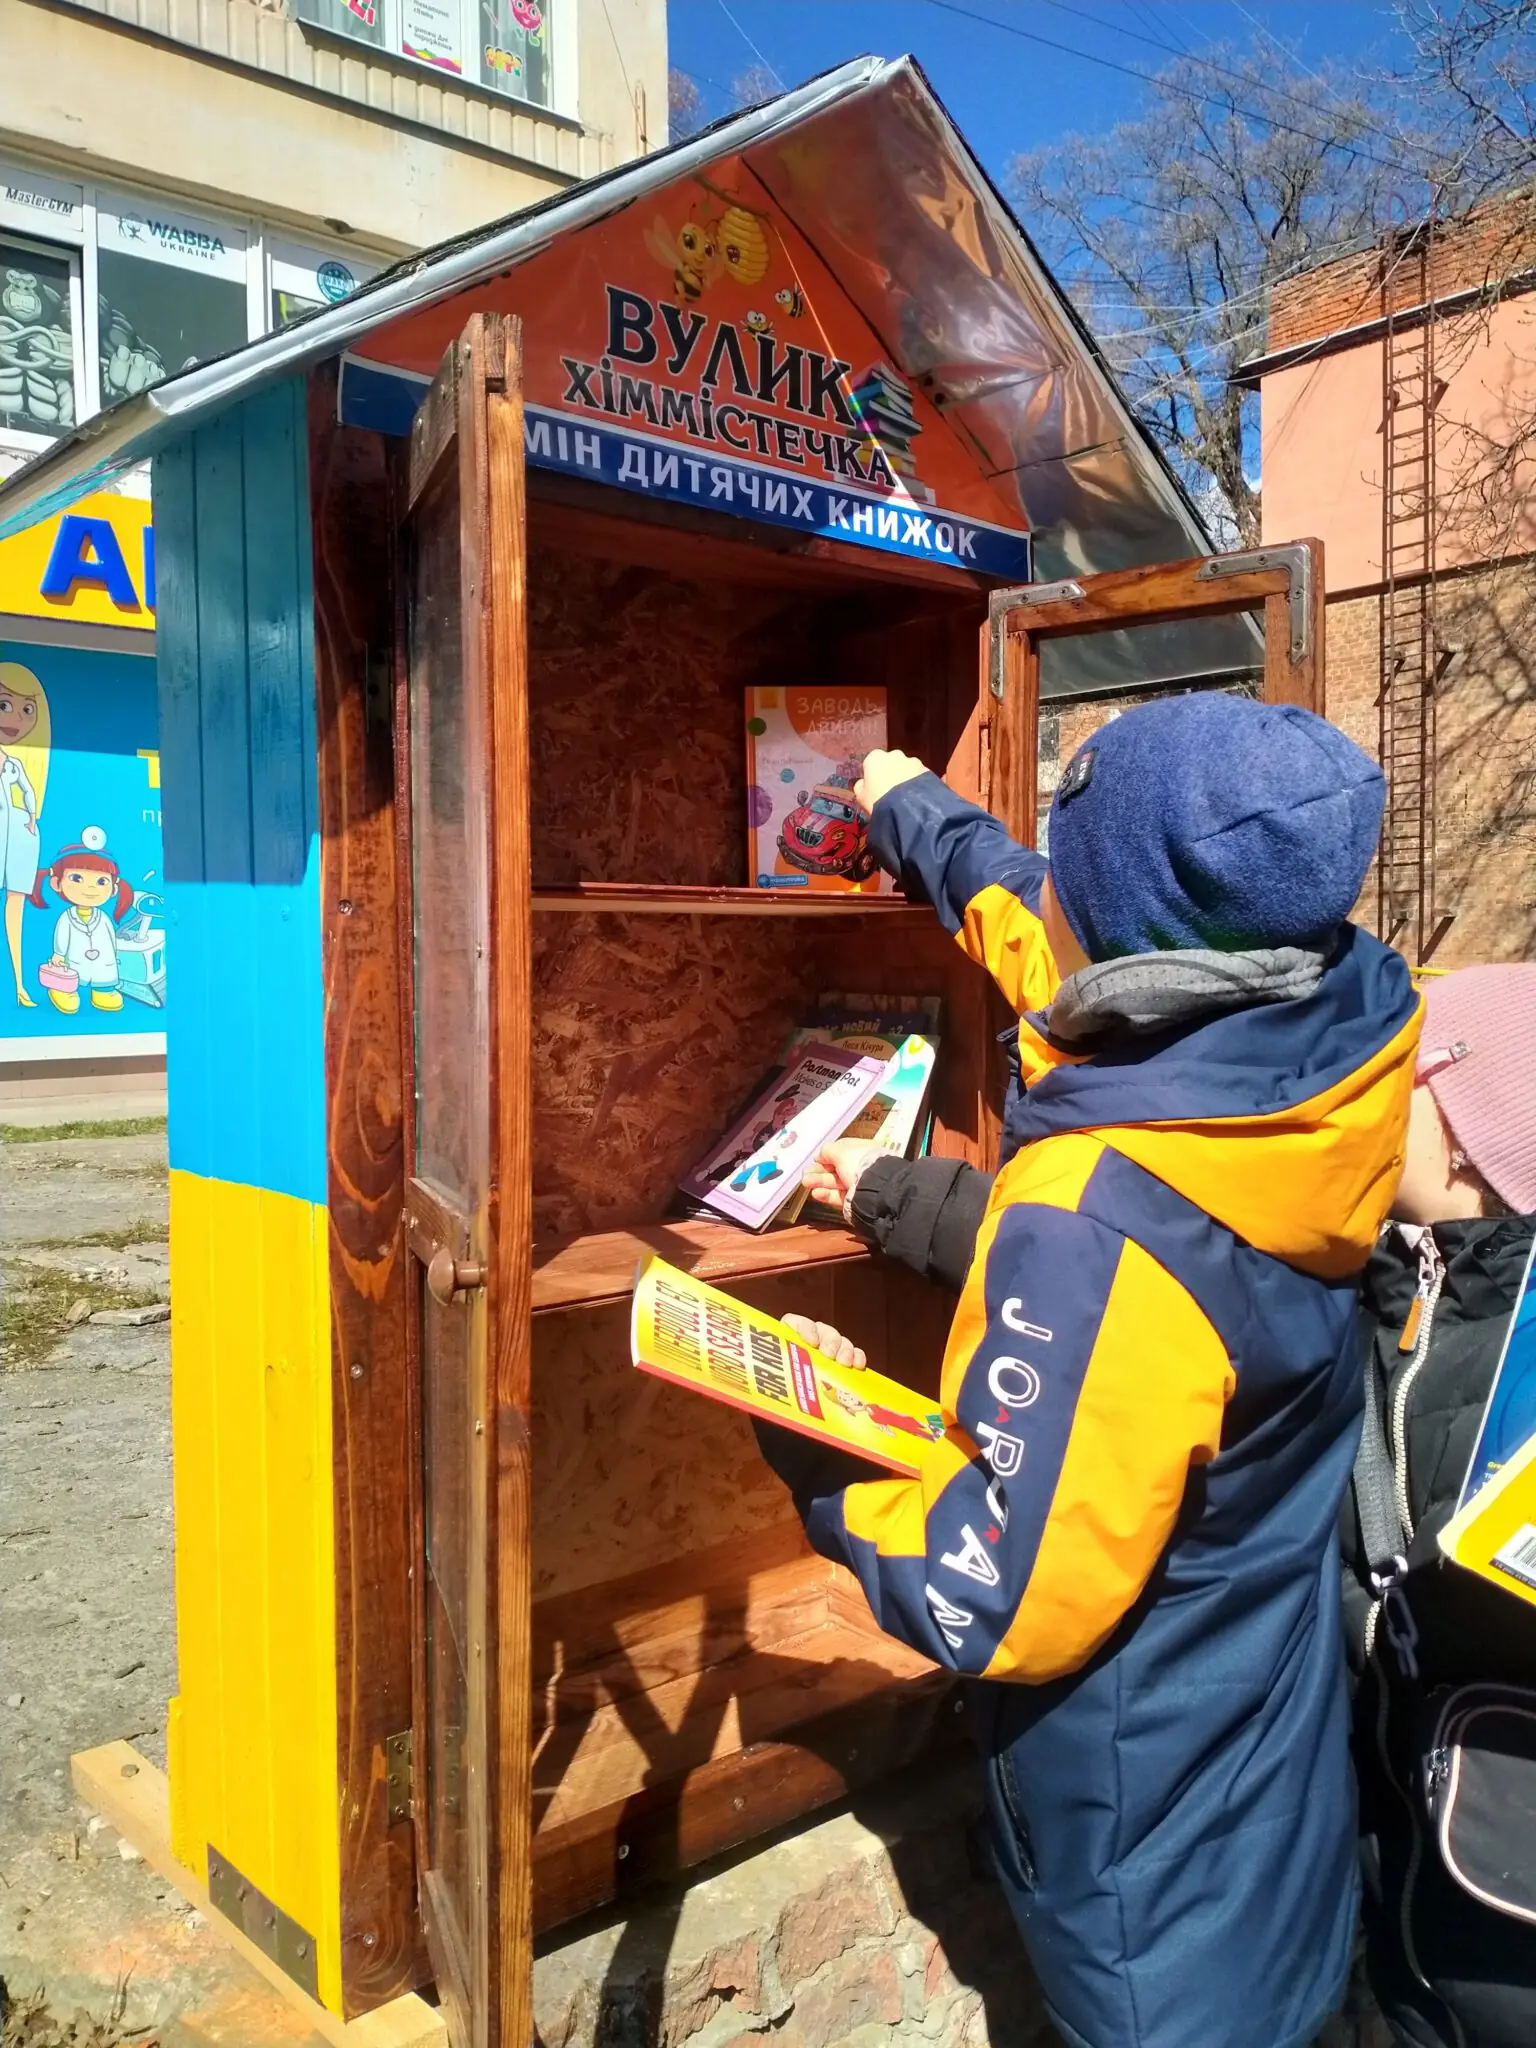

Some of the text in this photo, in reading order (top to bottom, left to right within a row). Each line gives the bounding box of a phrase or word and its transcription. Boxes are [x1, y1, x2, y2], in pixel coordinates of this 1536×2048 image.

[6, 187, 74, 214] MasterGYM
[147, 219, 226, 255] WABBA
[160, 240, 216, 261] UKRAINE
[605, 283, 857, 429] ВУЛИК
[618, 443, 815, 522] ДИТЯЧИХ
[828, 496, 977, 559] КНИЖОК
[800, 1059, 861, 1087] Postman Pat
[748, 1323, 792, 1407] FOR KIDS
